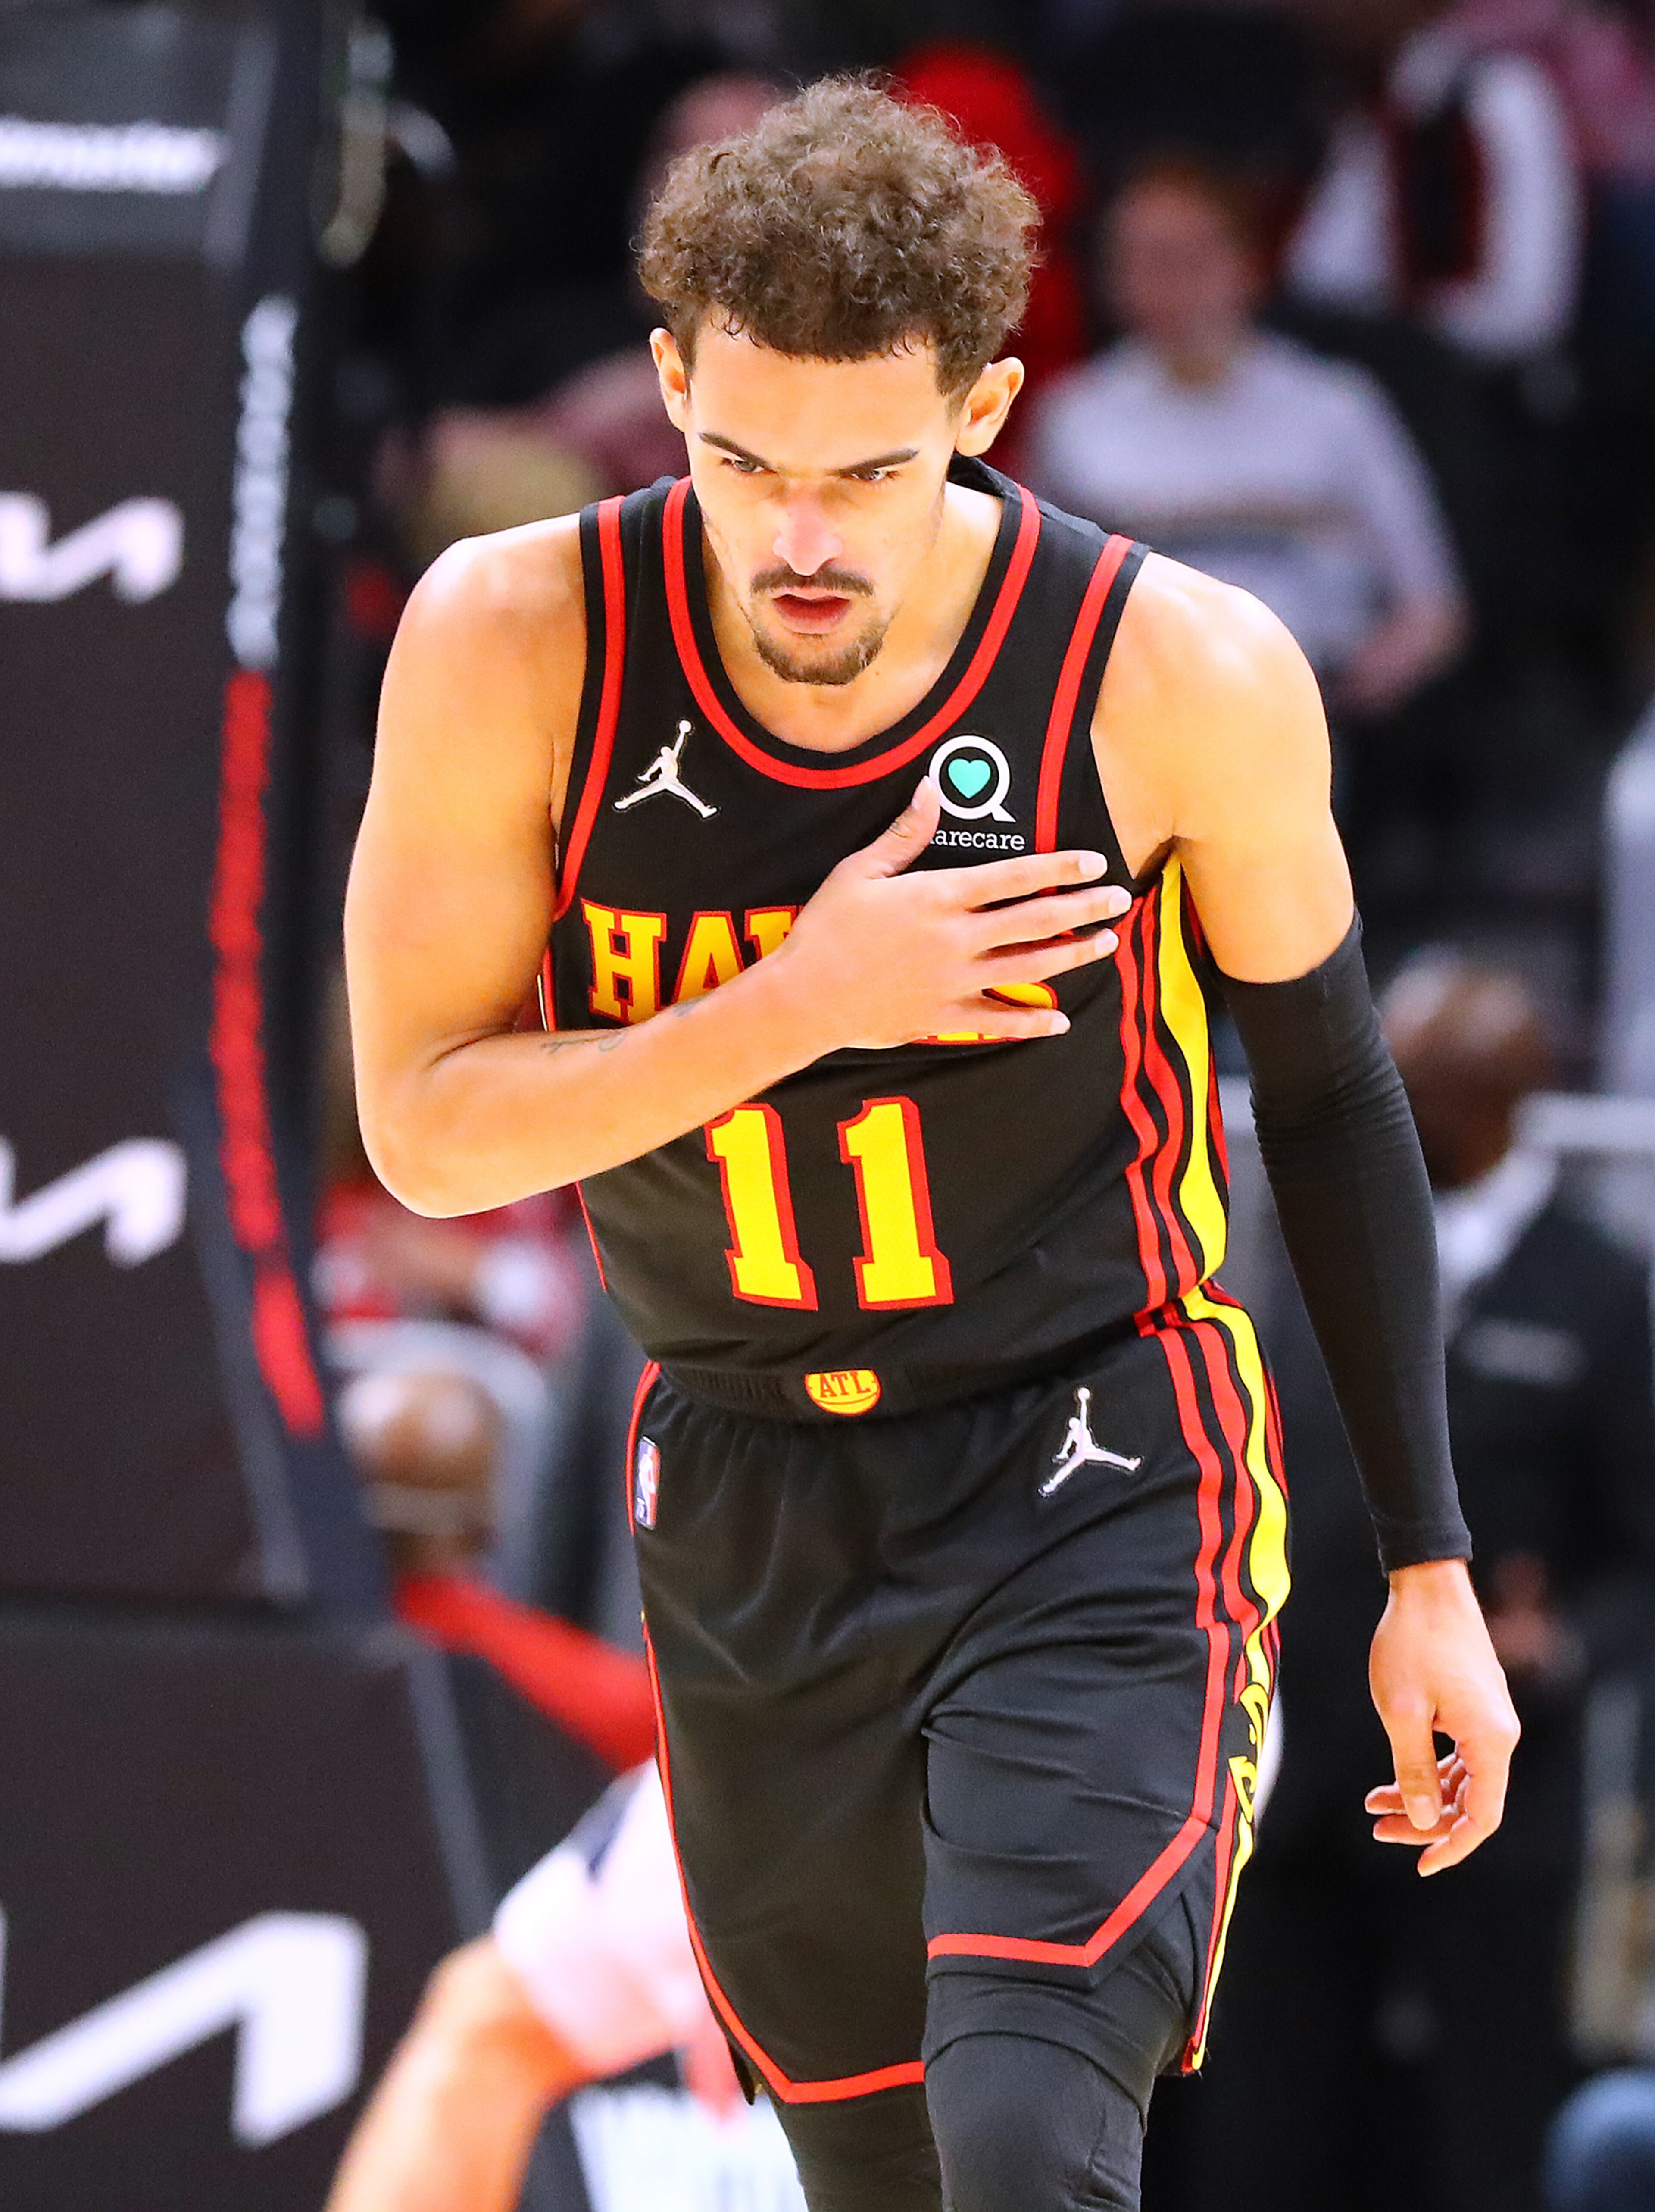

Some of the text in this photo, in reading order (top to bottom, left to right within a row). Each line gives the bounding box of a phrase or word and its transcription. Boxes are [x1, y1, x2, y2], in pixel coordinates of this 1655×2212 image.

[930, 829, 1025, 851] arecare
[704, 1095, 955, 1311] 11
[820, 1368, 871, 1398] ATL
